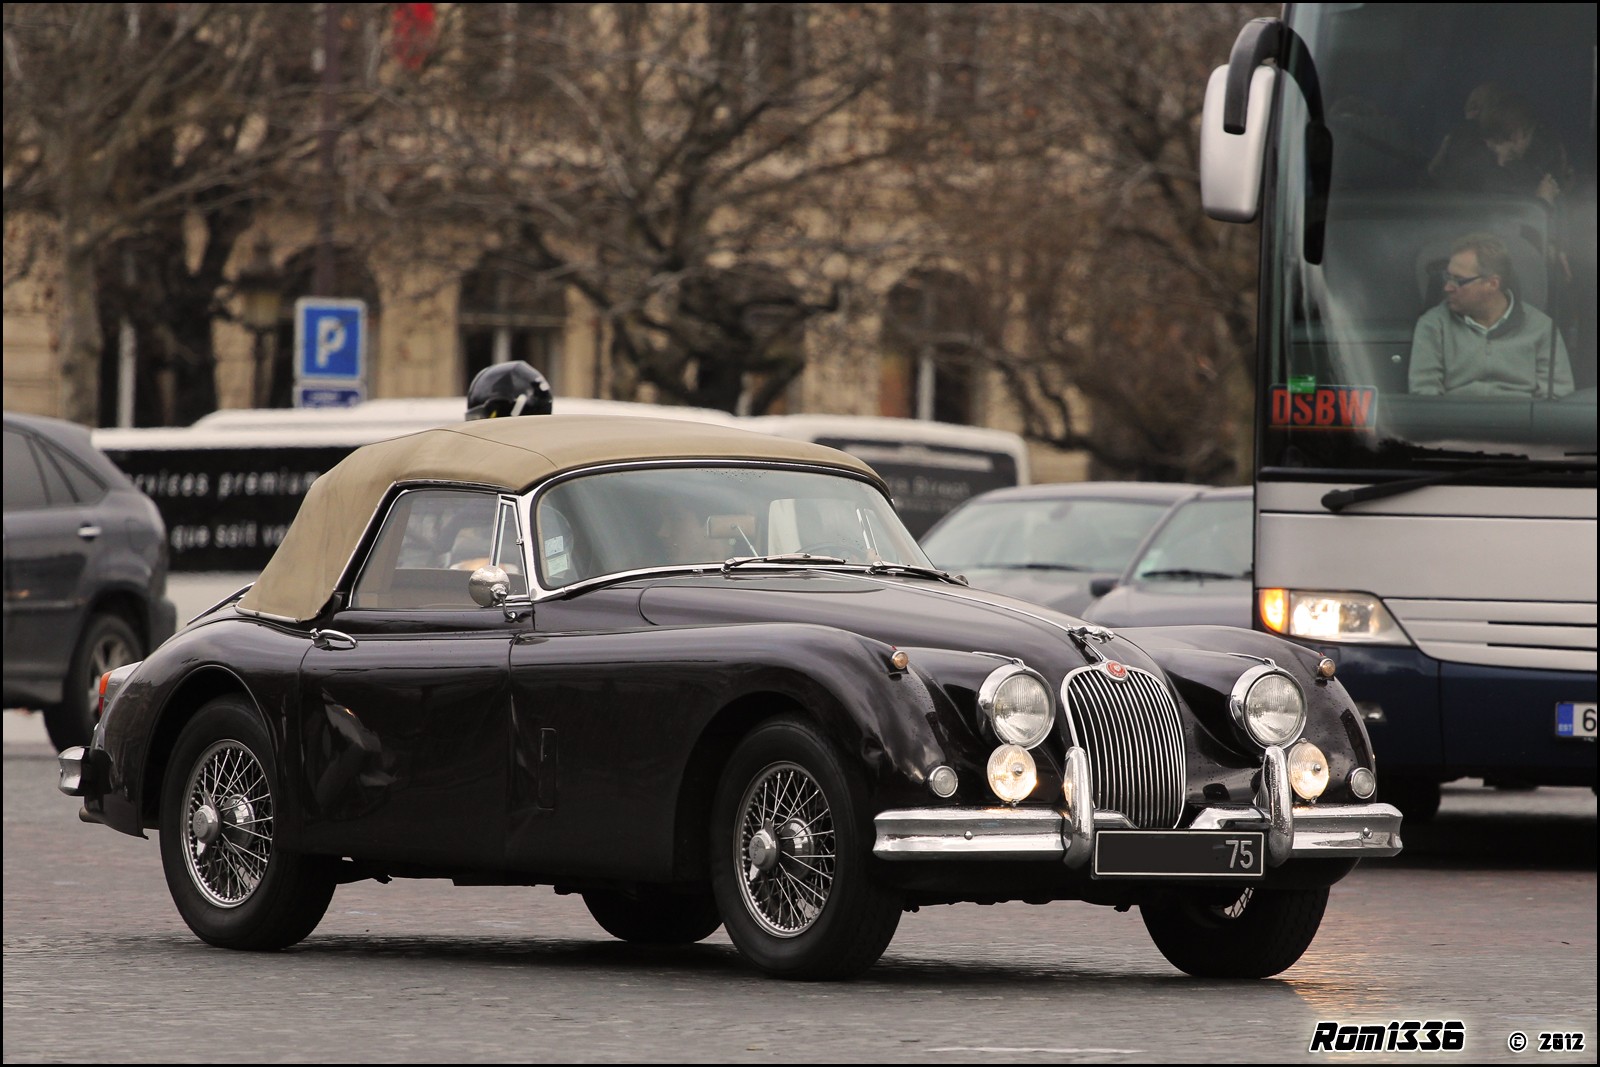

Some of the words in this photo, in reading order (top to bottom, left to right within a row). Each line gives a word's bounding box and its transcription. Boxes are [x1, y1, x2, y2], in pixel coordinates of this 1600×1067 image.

[316, 316, 347, 368] P
[1272, 389, 1372, 425] DSBW
[171, 524, 210, 553] que
[214, 520, 257, 548] soit
[1225, 840, 1254, 869] 75
